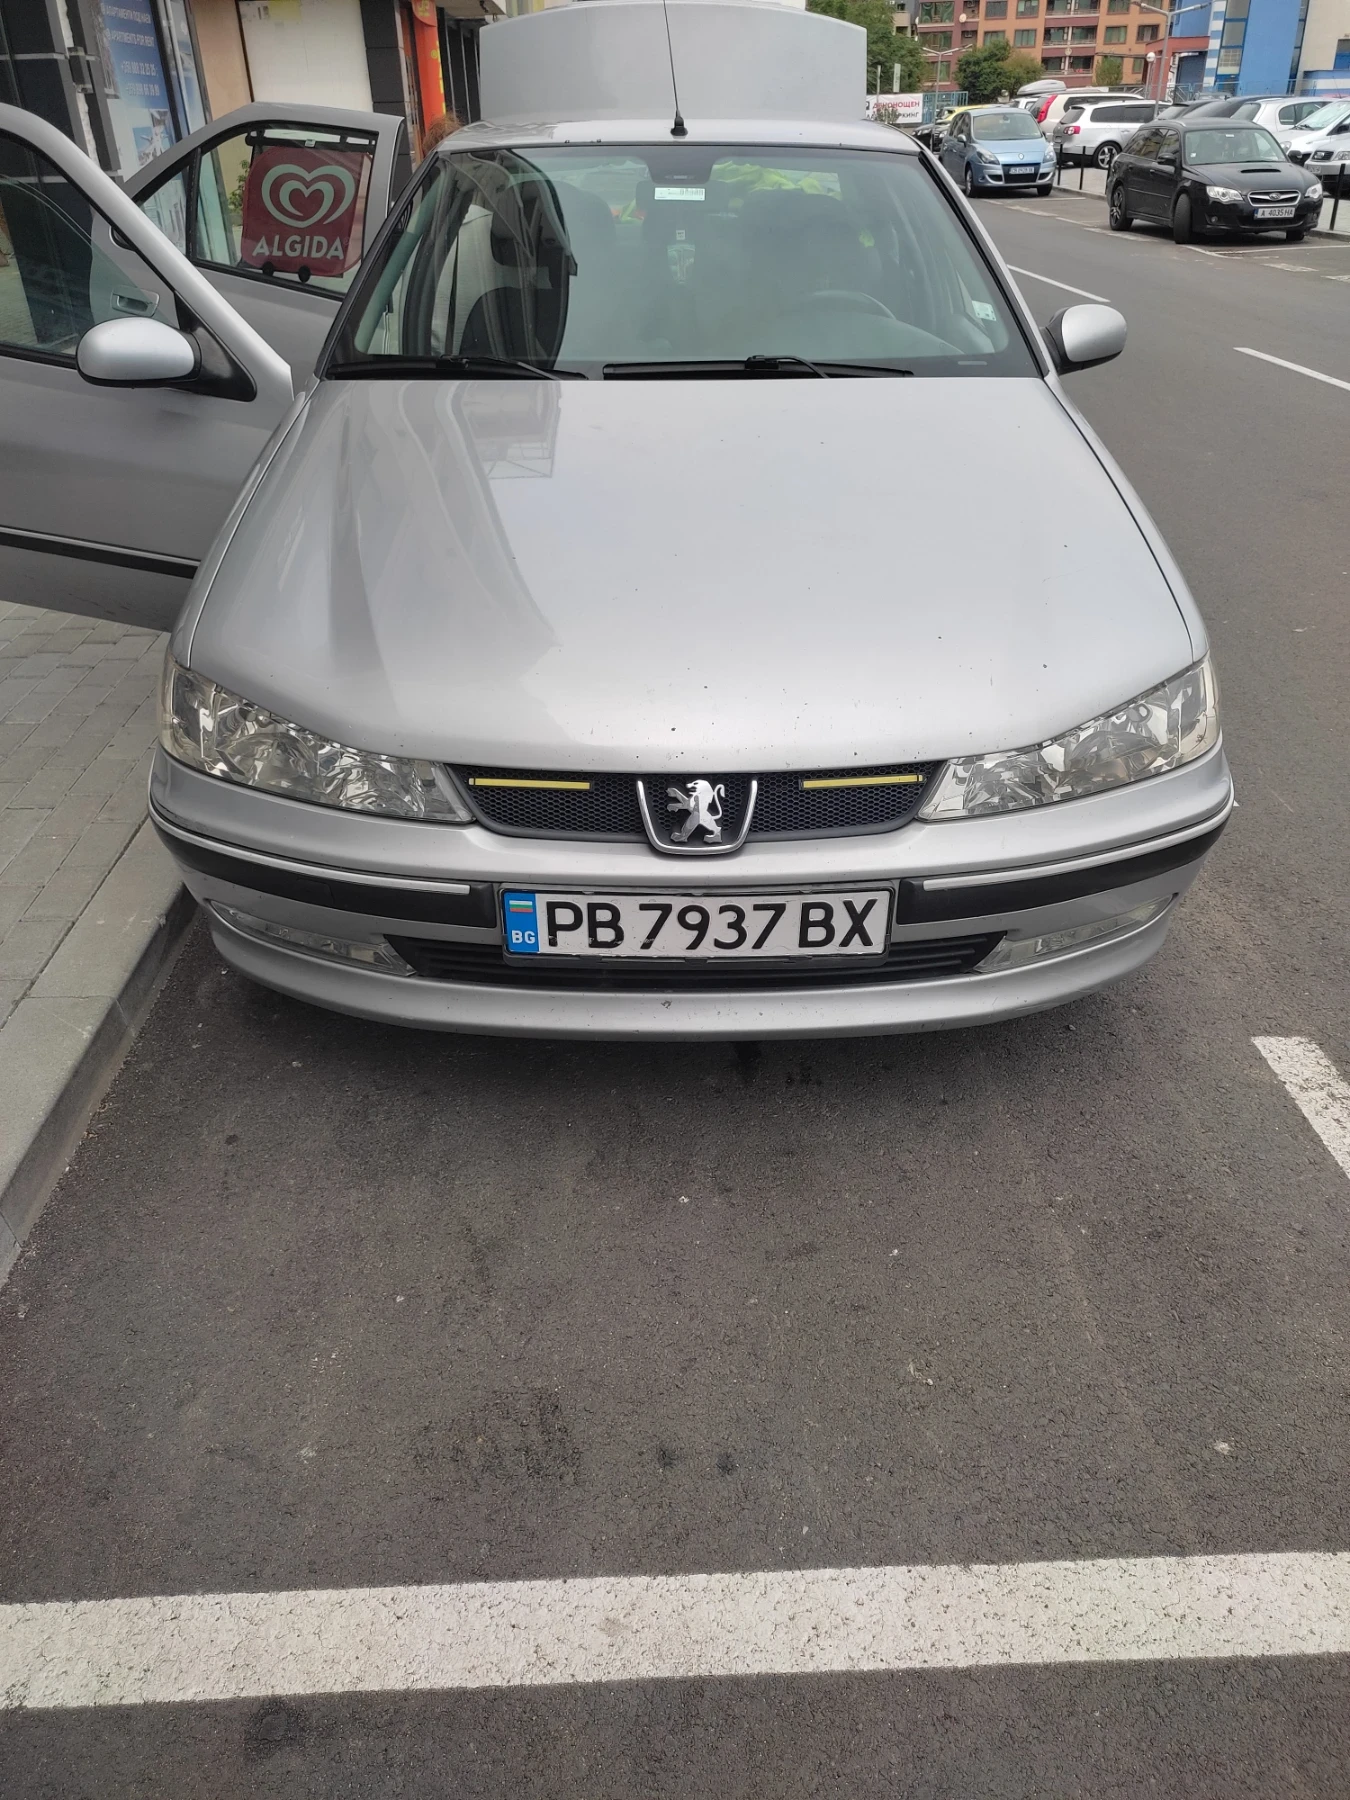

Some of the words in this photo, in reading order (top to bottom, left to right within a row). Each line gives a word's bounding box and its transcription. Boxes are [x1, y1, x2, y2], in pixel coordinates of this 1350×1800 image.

[1268, 209, 1284, 217] 4035
[252, 235, 345, 260] ALGIDA
[546, 901, 625, 948] PB
[638, 902, 787, 951] 7937
[798, 898, 879, 949] BX
[511, 930, 536, 944] BG
